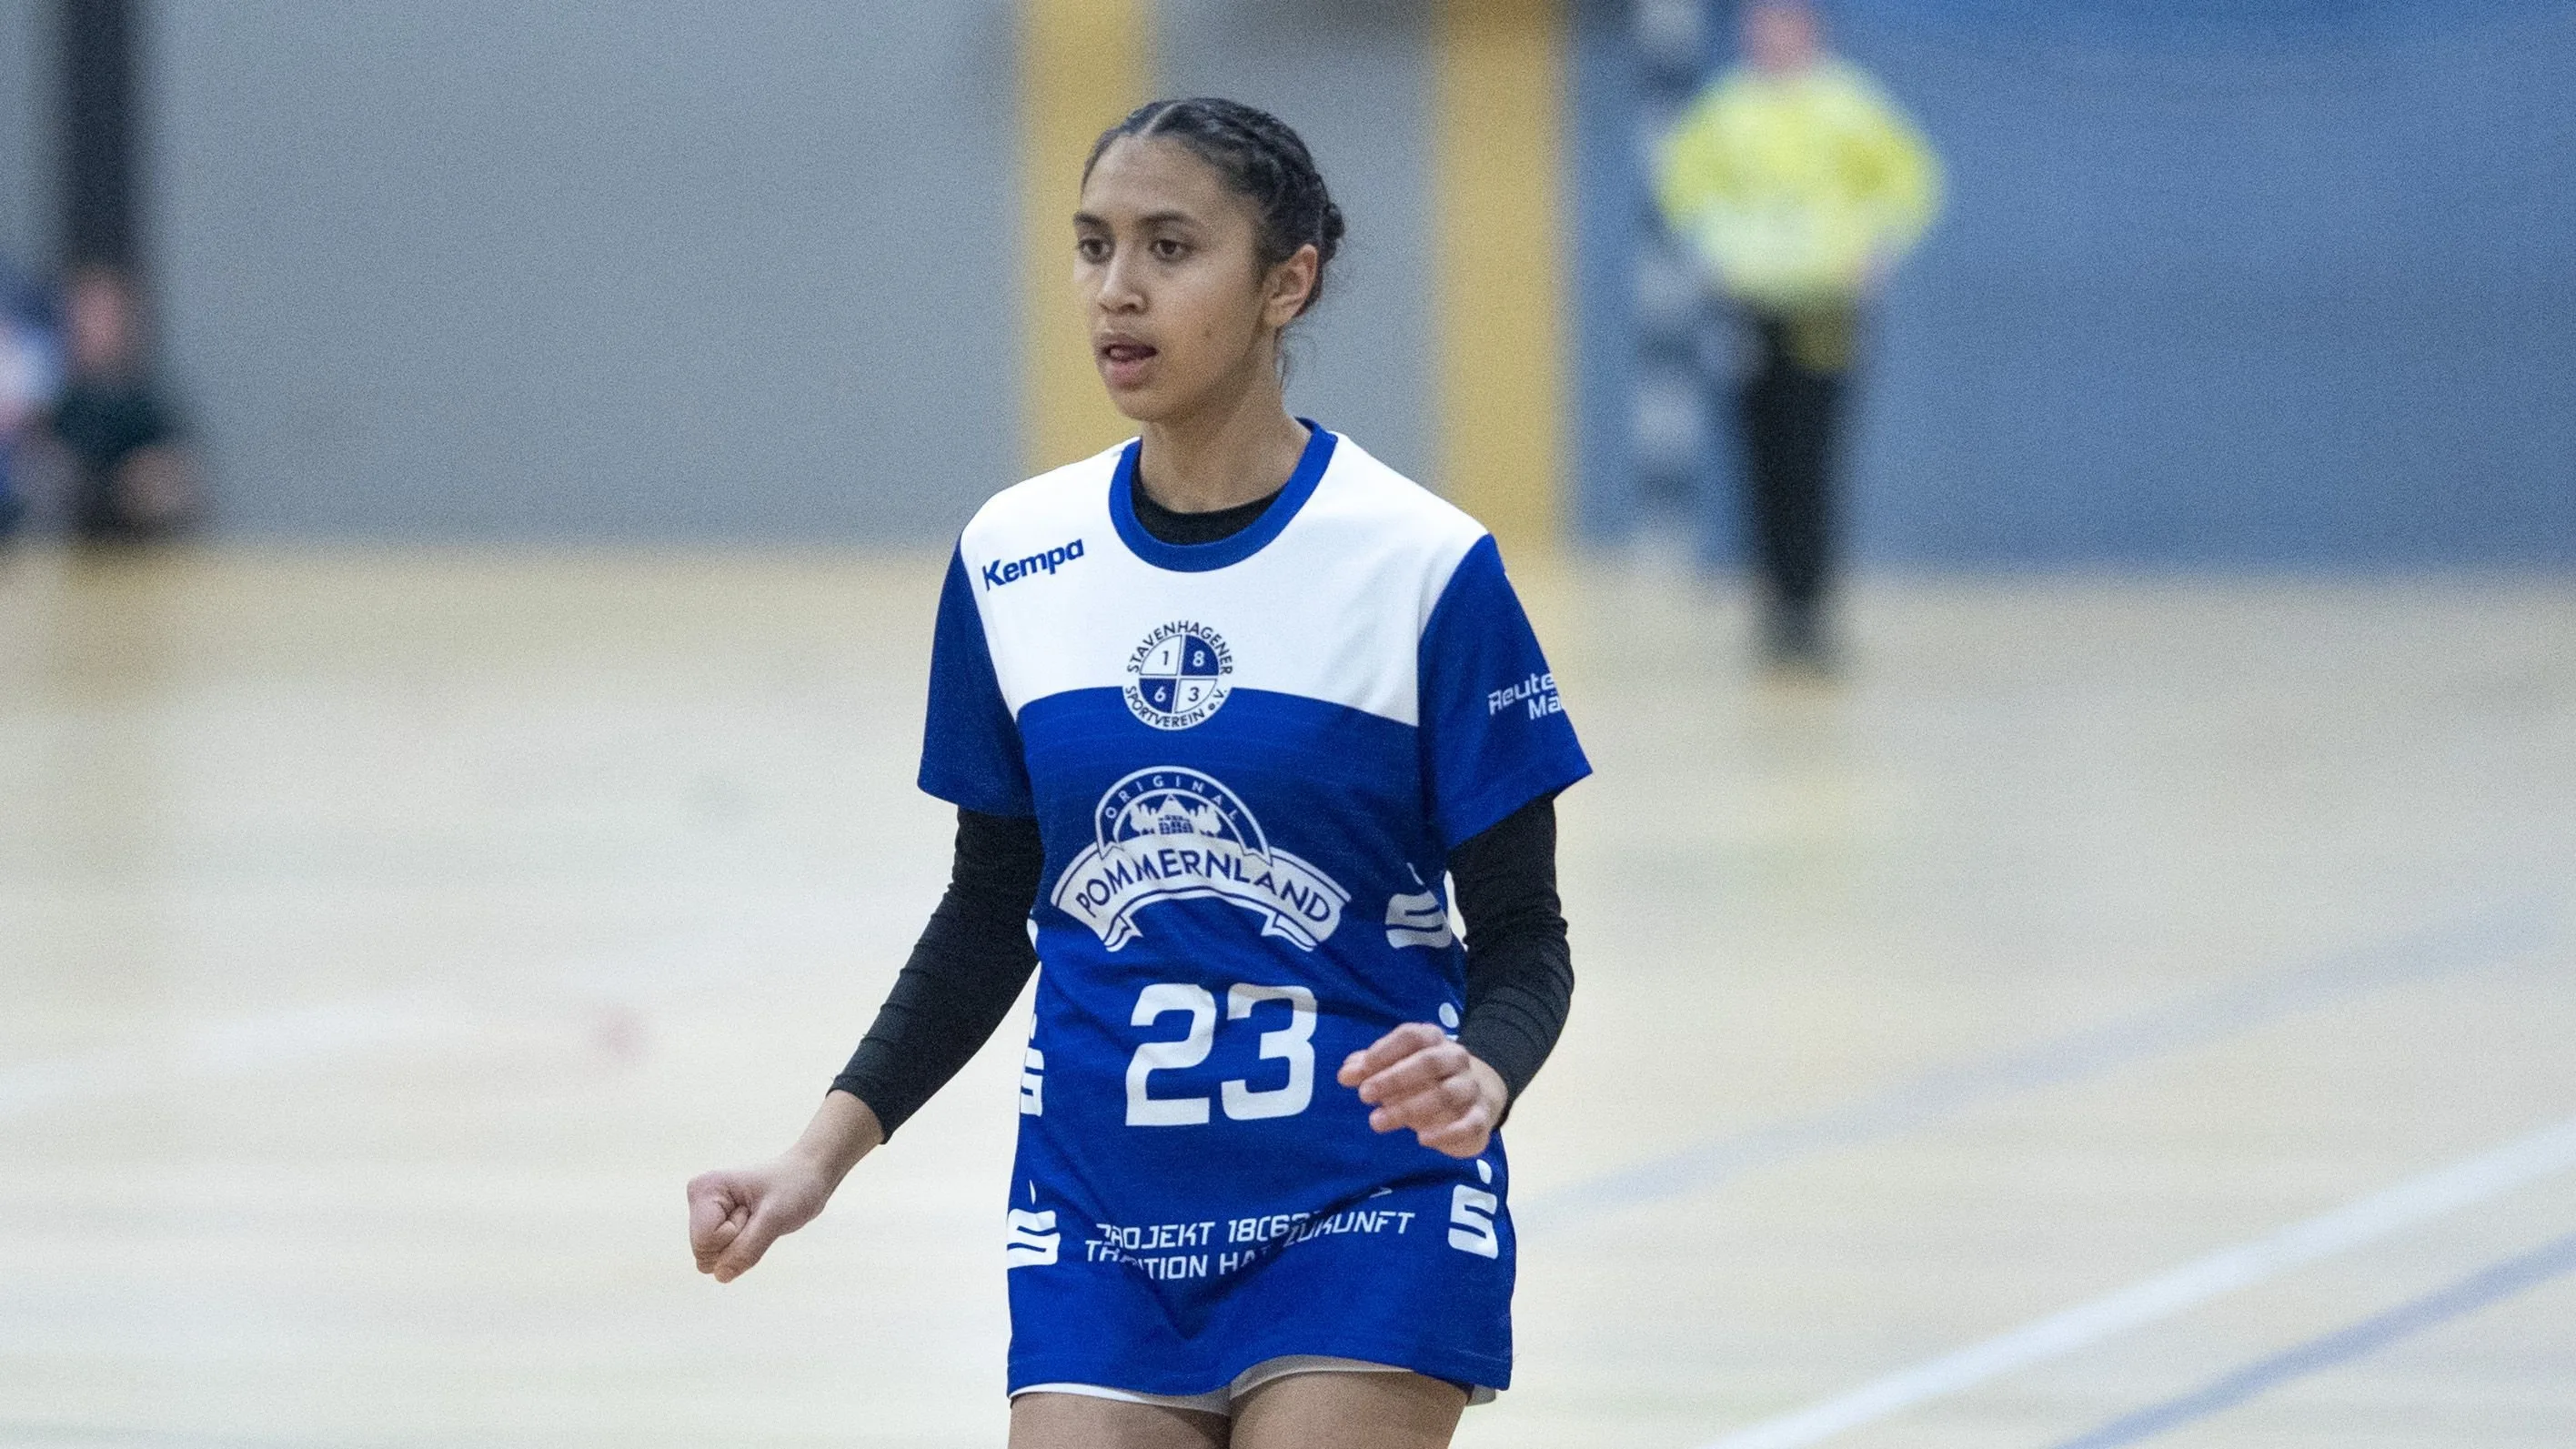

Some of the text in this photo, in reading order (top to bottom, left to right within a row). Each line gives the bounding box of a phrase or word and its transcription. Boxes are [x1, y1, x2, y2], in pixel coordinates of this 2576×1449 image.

[982, 538, 1084, 591] Kempa
[1126, 619, 1233, 675] STAVENHAGENER
[1162, 649, 1205, 668] 1 8
[1124, 685, 1205, 728] SPORTVEREIN
[1153, 685, 1200, 703] 6 3
[1106, 775, 1240, 820] ORIGINAL
[1074, 848, 1331, 923] POMMERNLAND
[1125, 982, 1318, 1127] 23
[1084, 1238, 1208, 1281] TRTION
[1219, 1245, 1272, 1275] HA
